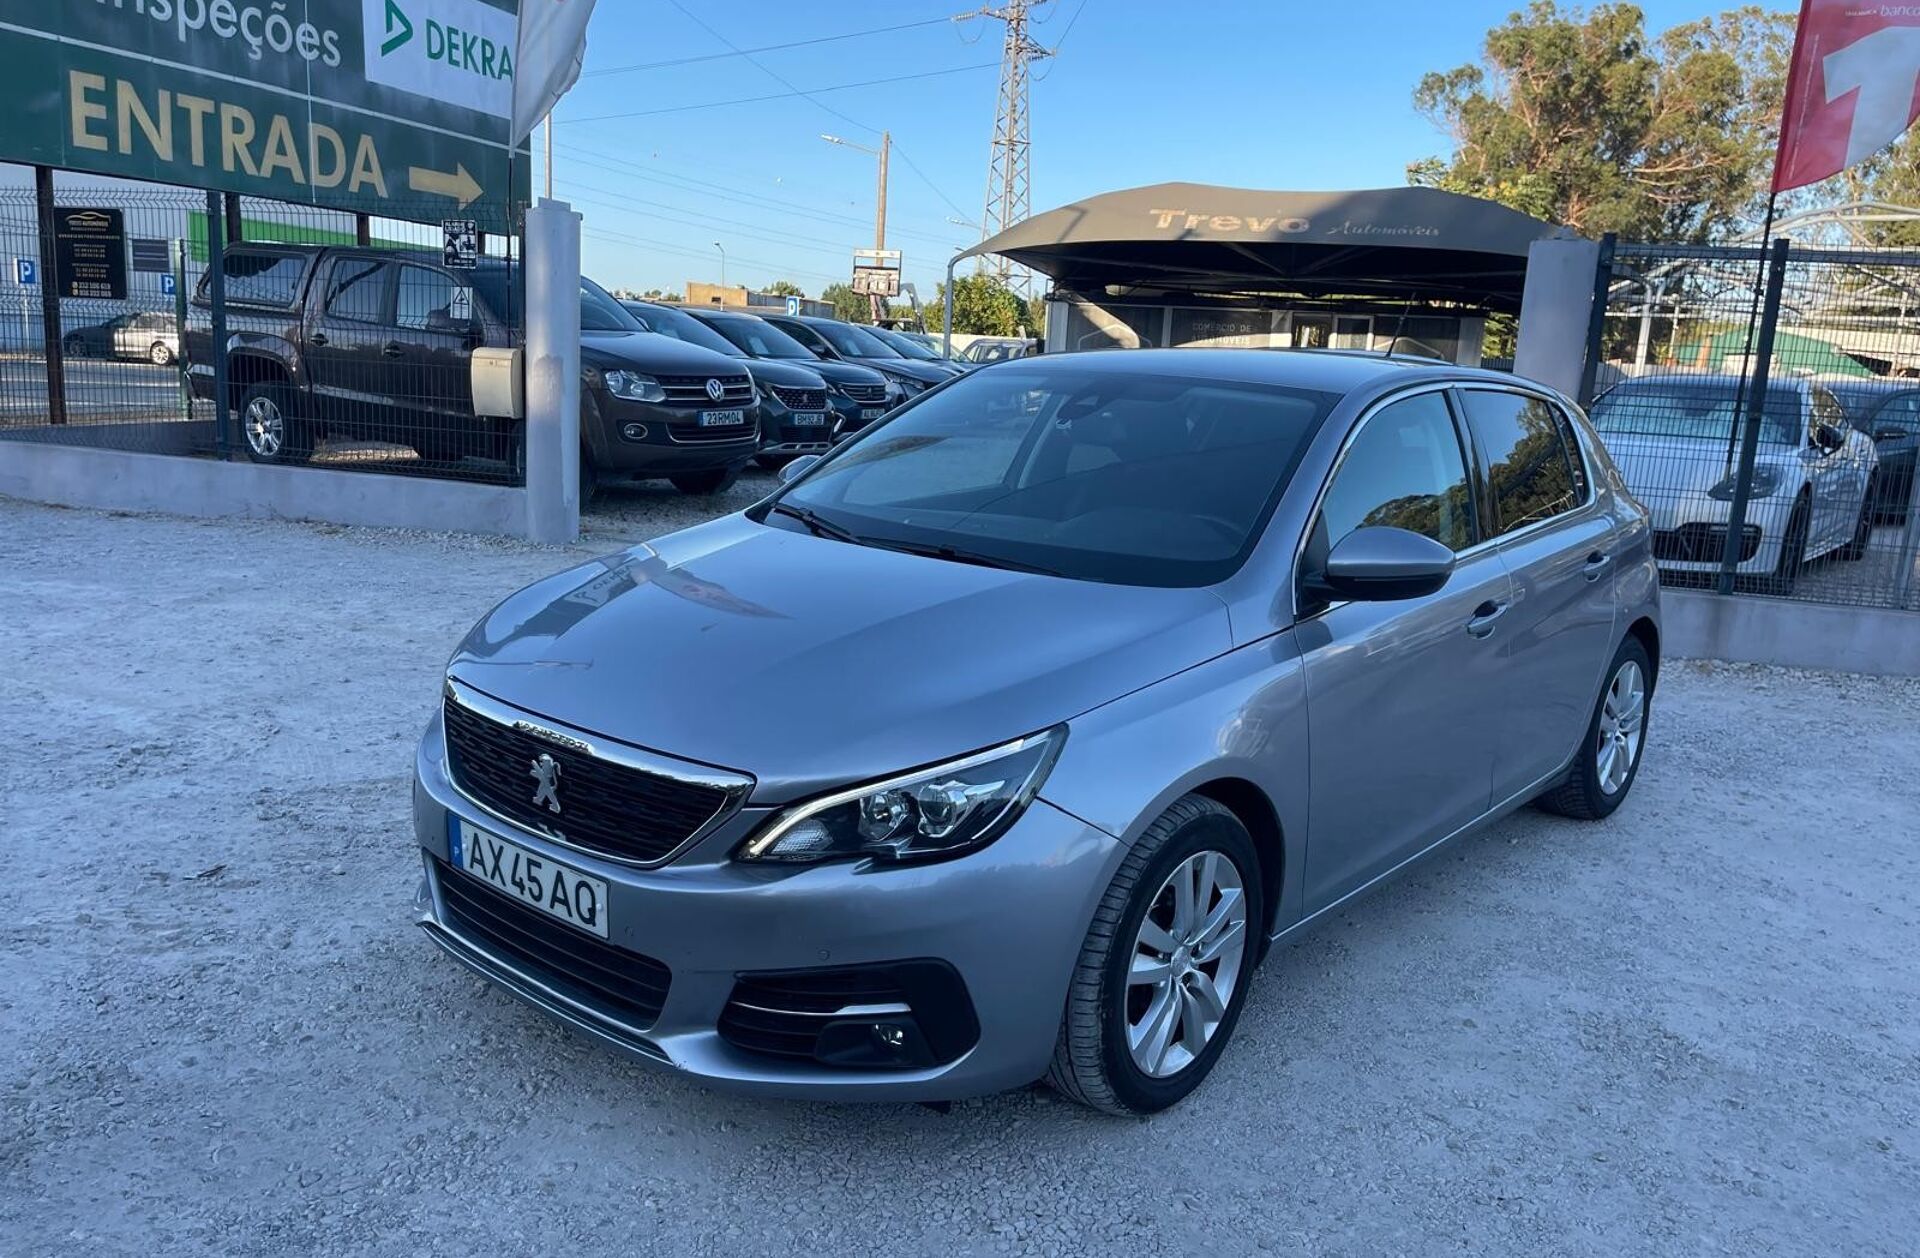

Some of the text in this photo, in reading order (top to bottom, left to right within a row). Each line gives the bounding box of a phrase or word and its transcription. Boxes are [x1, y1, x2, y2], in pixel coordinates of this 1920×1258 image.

[92, 0, 342, 67] speções
[426, 18, 513, 82] DEKRA
[69, 70, 390, 199] ENTRADA
[1150, 208, 1440, 236] Trevo Automóveis
[469, 832, 597, 927] AX45AQ
